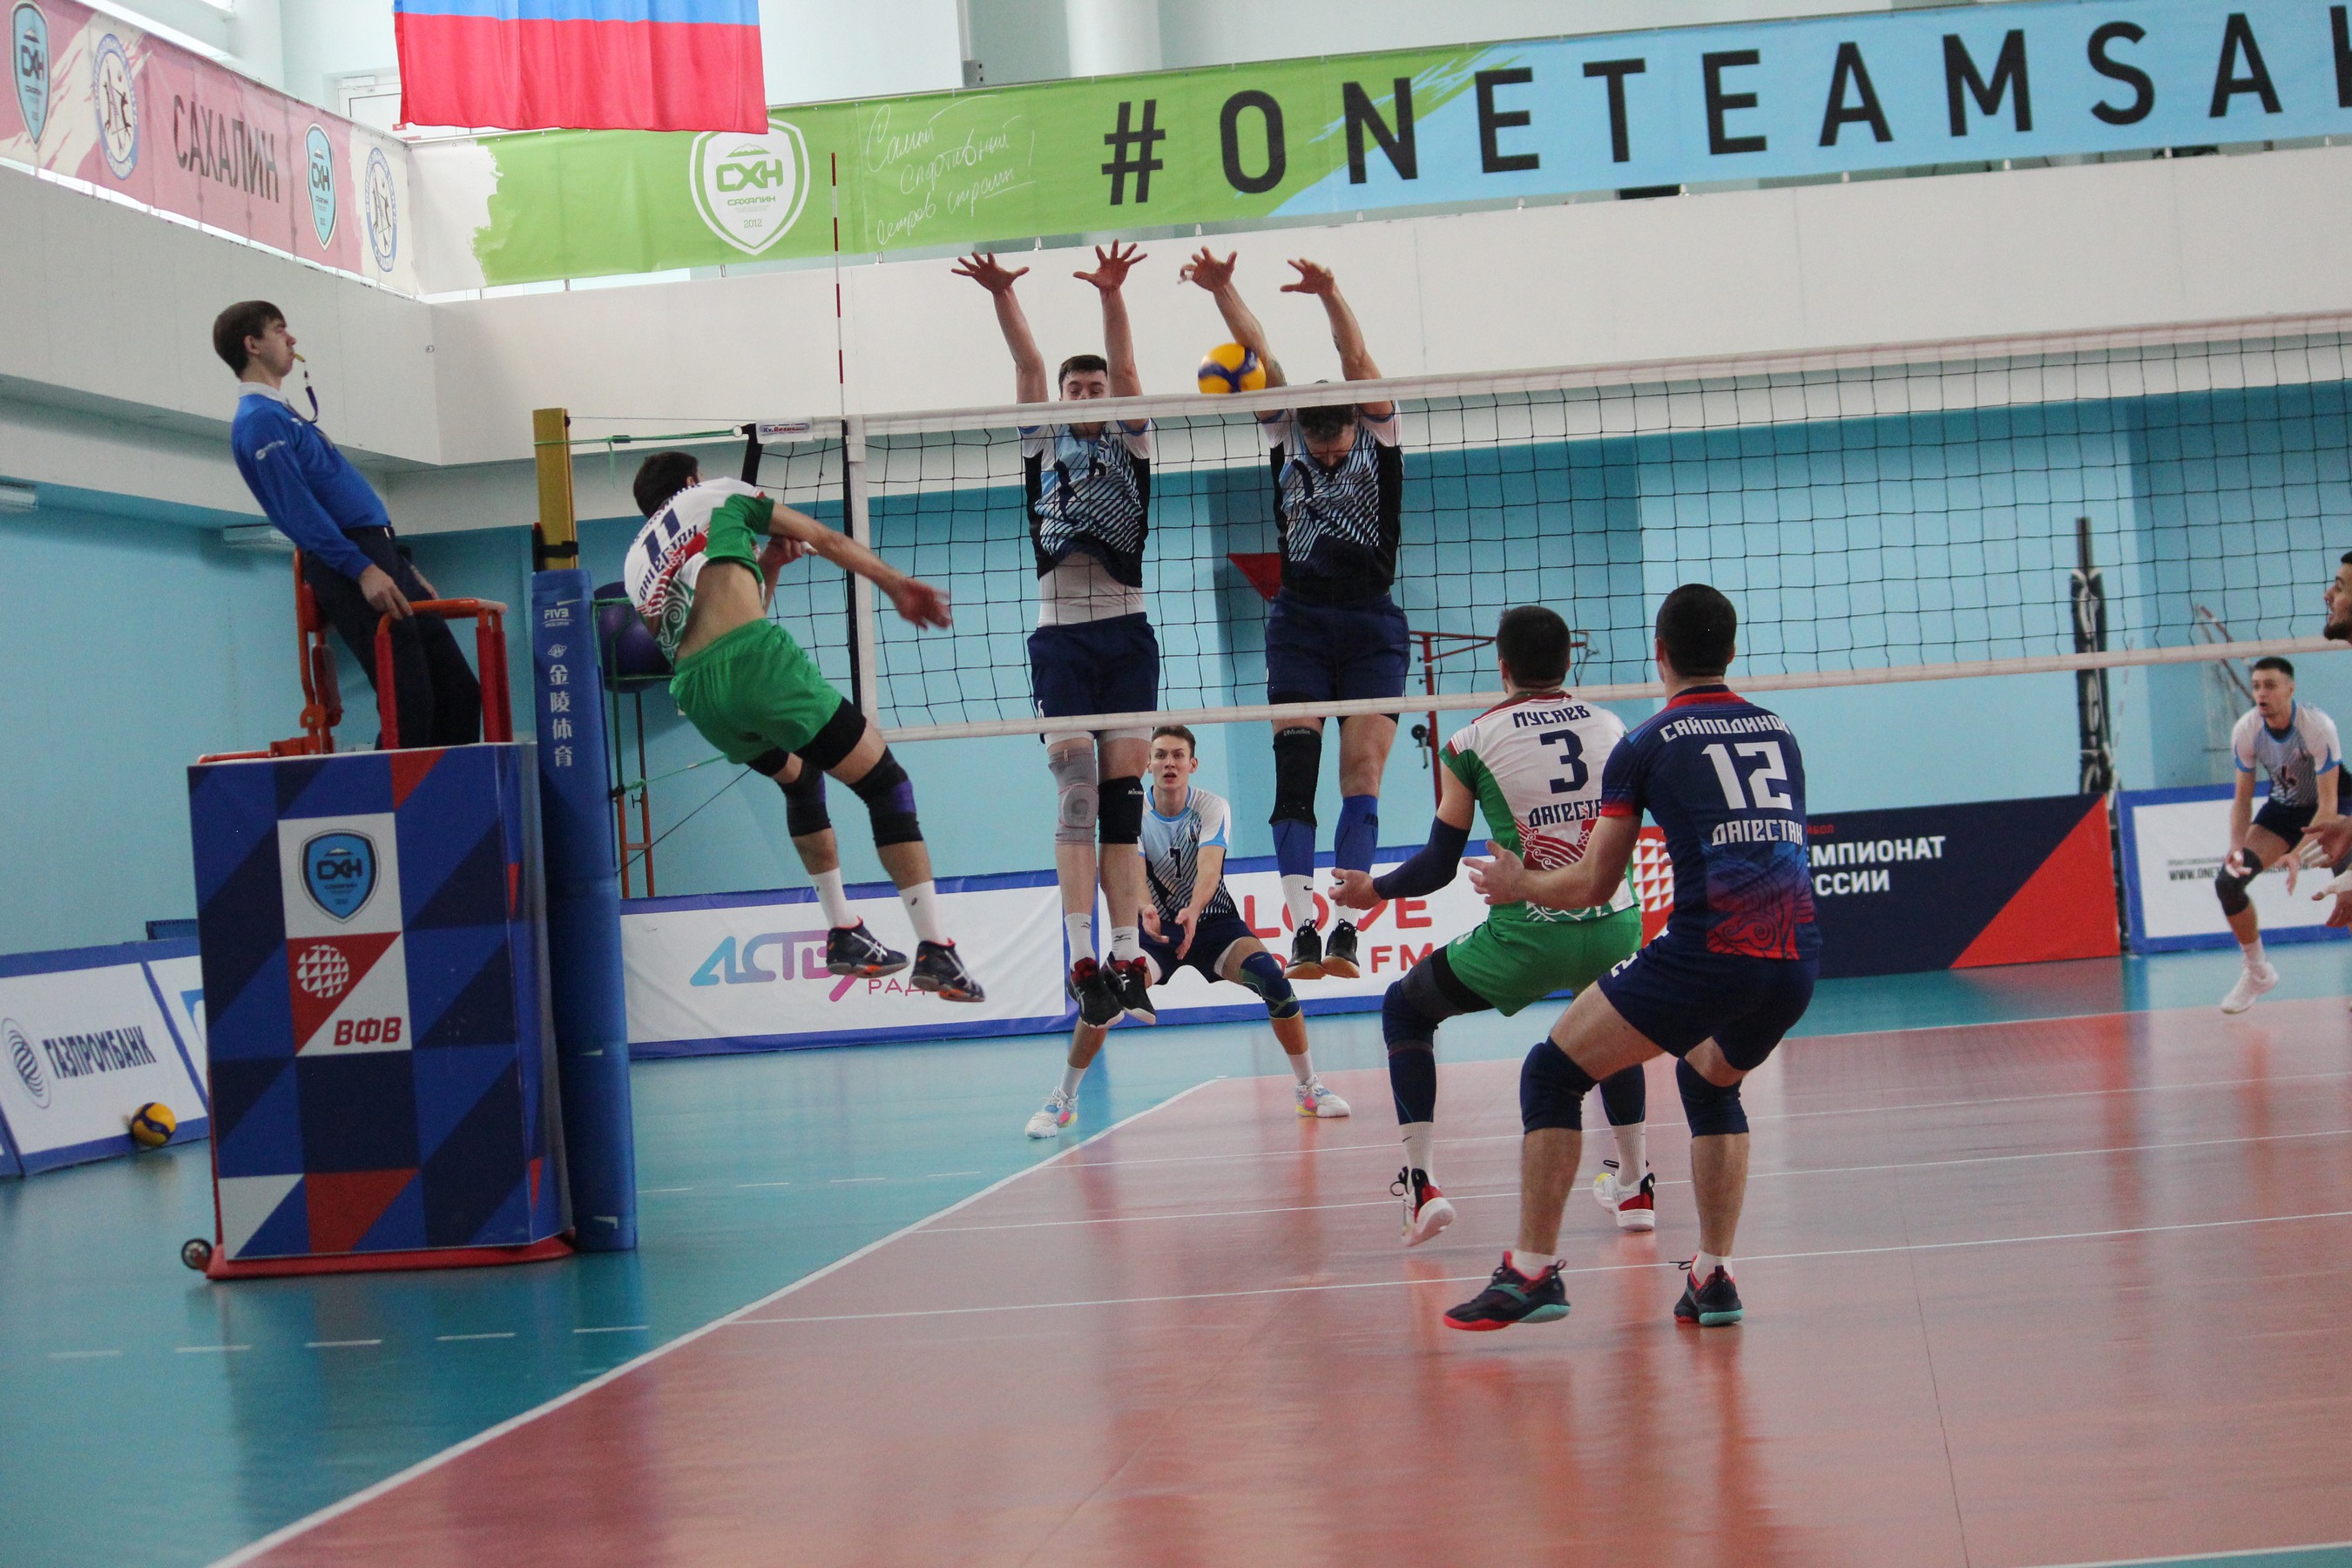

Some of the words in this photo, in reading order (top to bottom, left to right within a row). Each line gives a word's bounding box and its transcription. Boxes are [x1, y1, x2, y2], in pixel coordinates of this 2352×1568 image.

[173, 94, 280, 203] САХАЛИН
[727, 194, 776, 206] САХАЛИН
[743, 218, 763, 228] 2012
[544, 608, 570, 620] FIVB
[550, 664, 572, 767] 金陵体育
[1512, 705, 1591, 728] МУСАЕВ
[1539, 729, 1589, 794] 3
[1701, 741, 1793, 811] 12
[1712, 819, 1803, 847] ДАГЕСТАН
[1169, 847, 1182, 880] 7
[1807, 835, 1946, 868] МПИОНАТ
[1811, 869, 1890, 897] ССИИ
[868, 977, 926, 997] РАД
[334, 1017, 402, 1045] ВФВ
[42, 1025, 157, 1079] ГАЗПРОМБАНК
